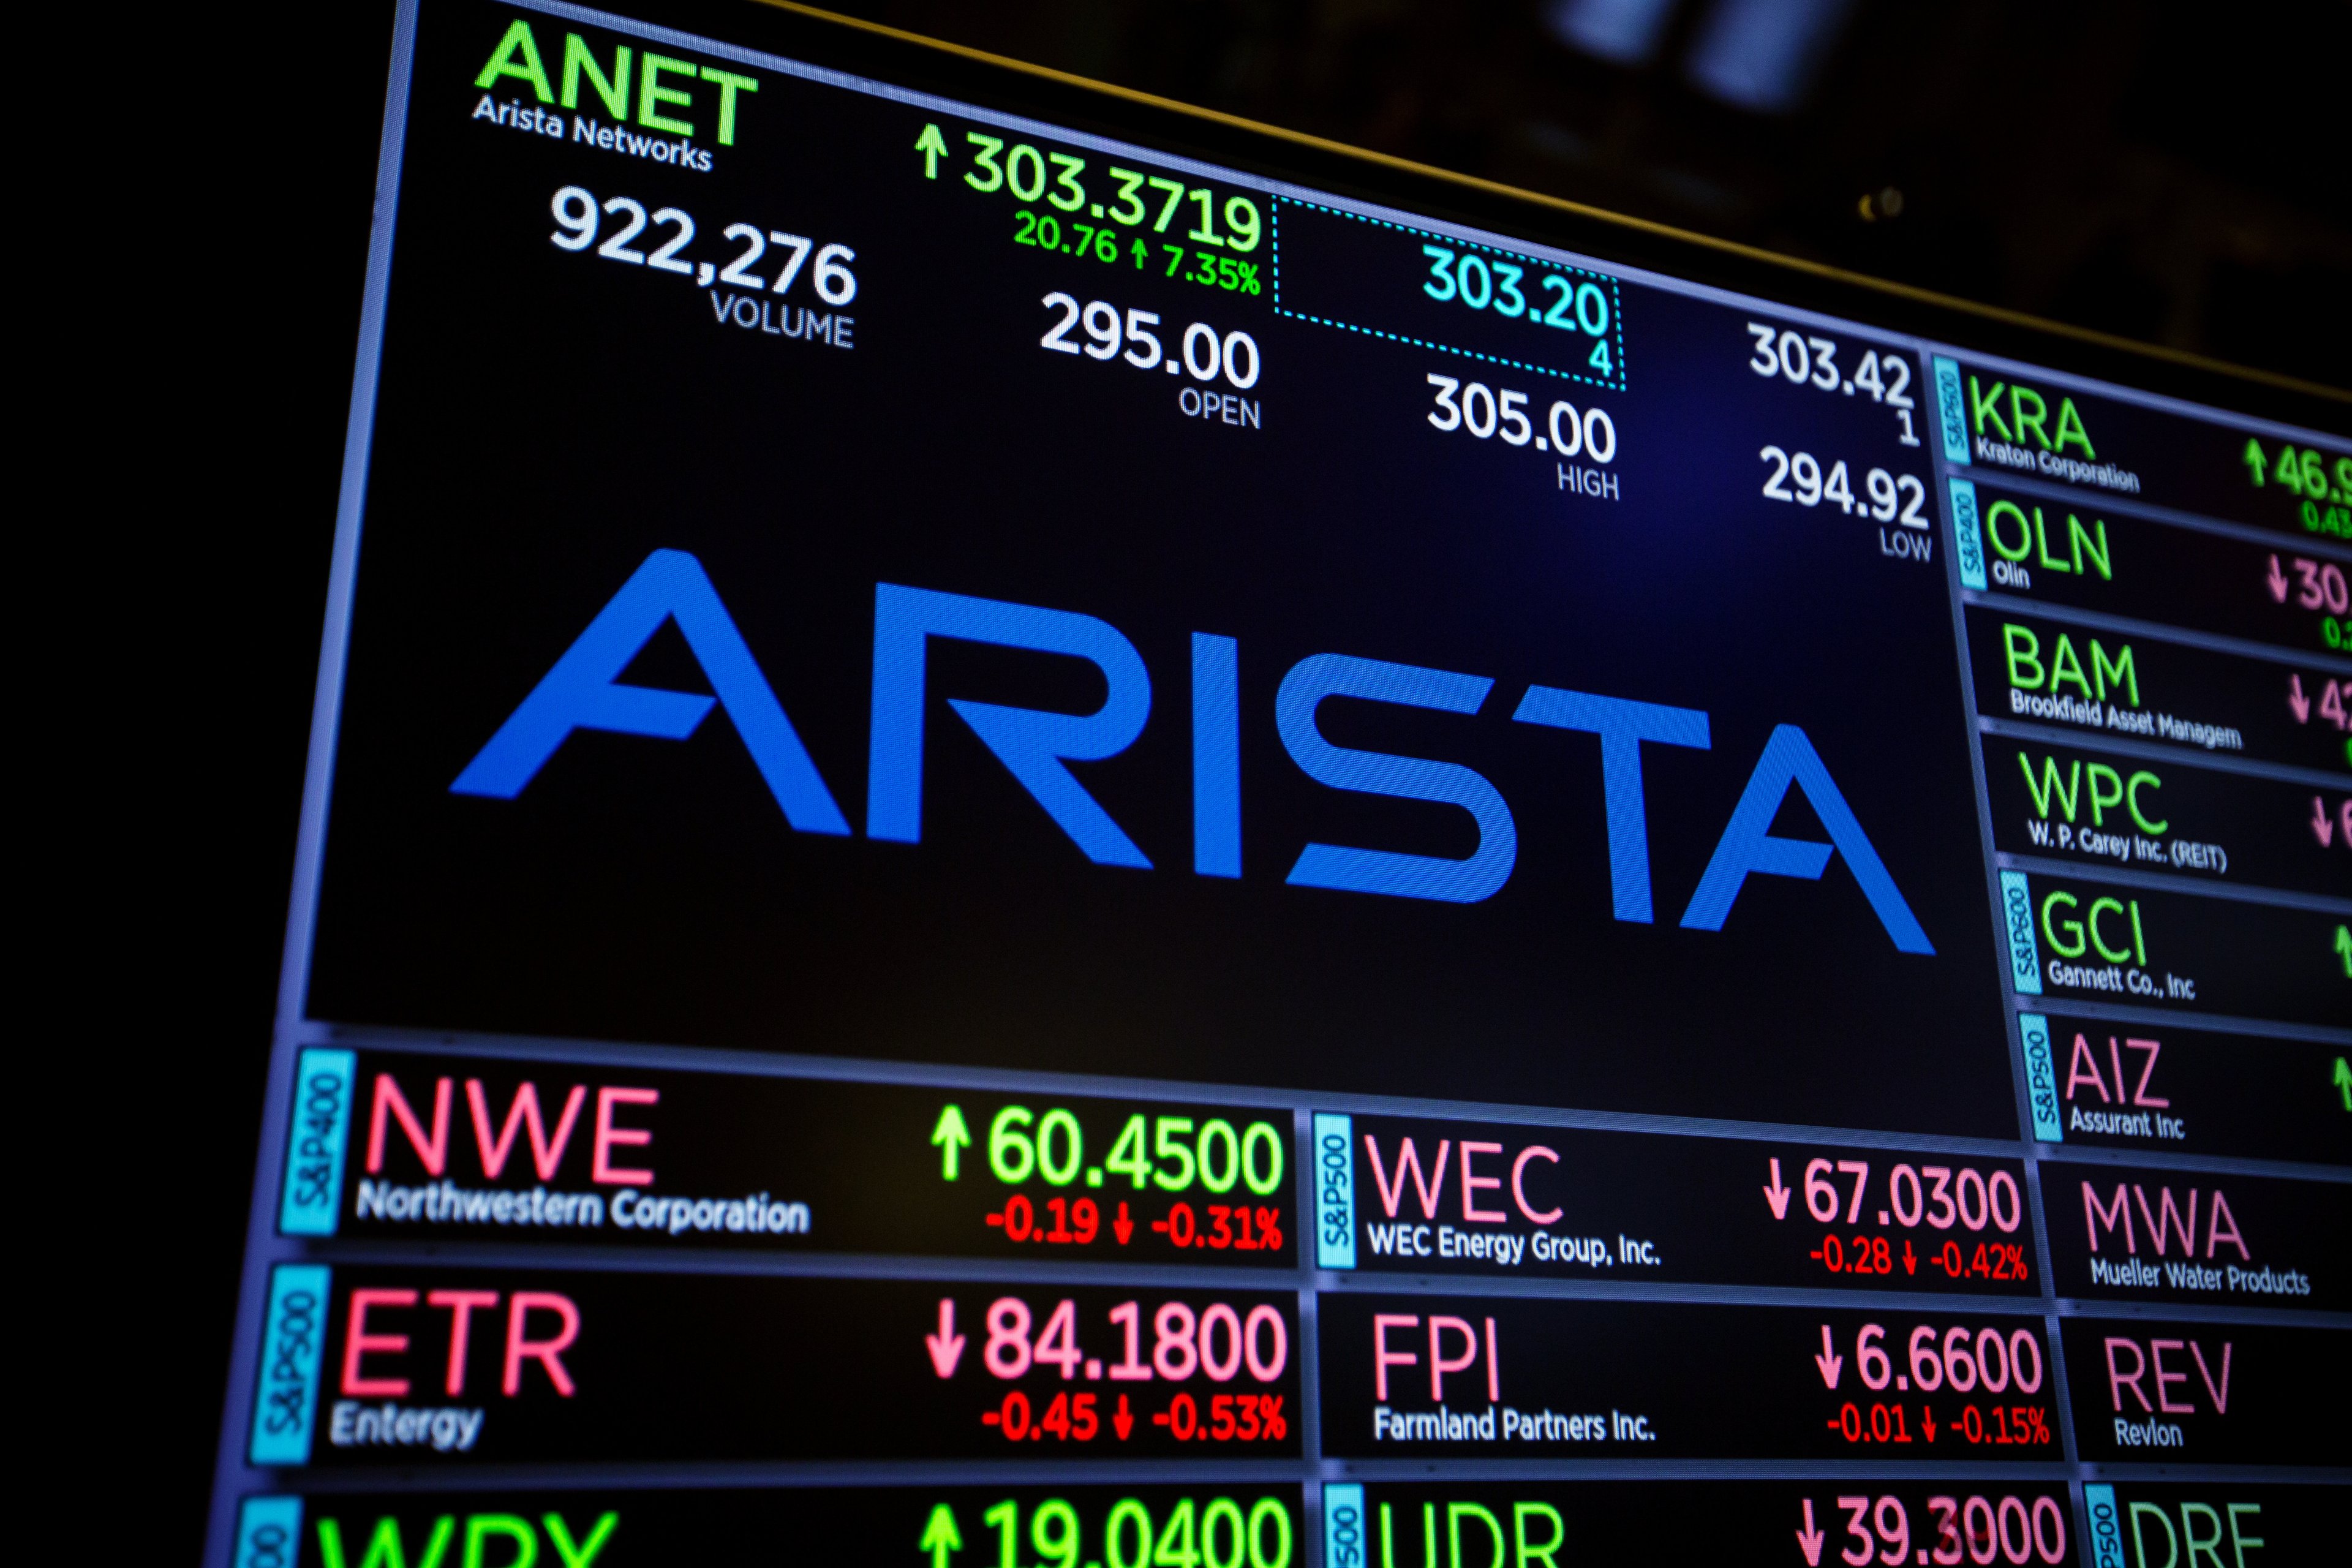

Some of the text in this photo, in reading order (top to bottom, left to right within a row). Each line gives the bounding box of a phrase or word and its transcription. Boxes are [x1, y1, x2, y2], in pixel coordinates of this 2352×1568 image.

[475, 18, 758, 146] ANET
[472, 93, 714, 172] Arista Networks
[963, 130, 1262, 252] 303.3719
[550, 185, 857, 306] 922,276
[1014, 209, 1261, 296] 20.76 7.35%
[710, 290, 854, 349] VOLUME
[1422, 244, 1610, 336] 303.20
[1040, 291, 1261, 389] 295.00
[1588, 339, 1613, 377] 4
[1747, 322, 1915, 410] 303.42
[1178, 386, 1262, 429] OPEN
[1427, 372, 1617, 464] 305.00
[1896, 409, 1920, 447] 1
[1969, 375, 2095, 461] KRA
[1557, 462, 1620, 501] HIGH
[1760, 445, 1929, 530] 294.92
[1975, 435, 2141, 493] Kraton Corporation
[1879, 527, 1932, 563] LOW
[1956, 492, 1981, 573] S&P400
[1987, 499, 2113, 581] OLN
[1992, 560, 2031, 589] Olin
[2003, 622, 2140, 707] BAM
[448, 547, 1938, 956] ARISTA
[2010, 687, 2243, 750] Brookfield Asset Managem
[2018, 751, 2168, 834] WPC
[2027, 819, 2228, 875] W. P. Carey Inc. (REIT)
[2008, 886, 2037, 977] S&P600
[2041, 890, 2147, 967] GCI
[2048, 960, 2196, 1001] Gannett Co., Inc
[2028, 1030, 2056, 1125] S&P500
[2065, 1033, 2170, 1109] AIZ
[295, 1071, 342, 1209] S&P400
[365, 1072, 659, 1185] NWE
[987, 1105, 1284, 1195] 60.4500
[2070, 1106, 2185, 1140] Assurant Inc
[356, 1178, 811, 1235] Northwestern Corporation
[1323, 1134, 1348, 1247] S&P500
[1364, 1134, 1563, 1224] WEC
[1804, 1158, 2021, 1232] 67.0300
[986, 1194, 1283, 1251] -0.19 -0.31%
[1367, 1221, 1661, 1267] WEC Energy Group, Inc.
[1810, 1234, 2028, 1281] -0.28 -0.42%
[2082, 1180, 2251, 1262] MWA
[2090, 1257, 2311, 1297] Mueller Water Products
[266, 1289, 317, 1435] S&P500
[340, 1287, 581, 1398] ETR
[984, 1297, 1288, 1382] 84.1800
[1374, 1313, 1499, 1401] FPI
[1856, 1323, 2043, 1393] 6.6600
[2104, 1336, 2232, 1415] REV
[330, 1400, 484, 1452] Entergy
[982, 1391, 1287, 1440] -0.45 -0.53%
[1374, 1405, 1656, 1441] Farmland Partners Inc.
[1827, 1402, 2050, 1444] -0.01 -0.15%
[2114, 1415, 2184, 1448] Revlon
[984, 1496, 1293, 1568] 19.0400
[1379, 1501, 1565, 1568] UDR
[1838, 1495, 2066, 1566] 39.3000
